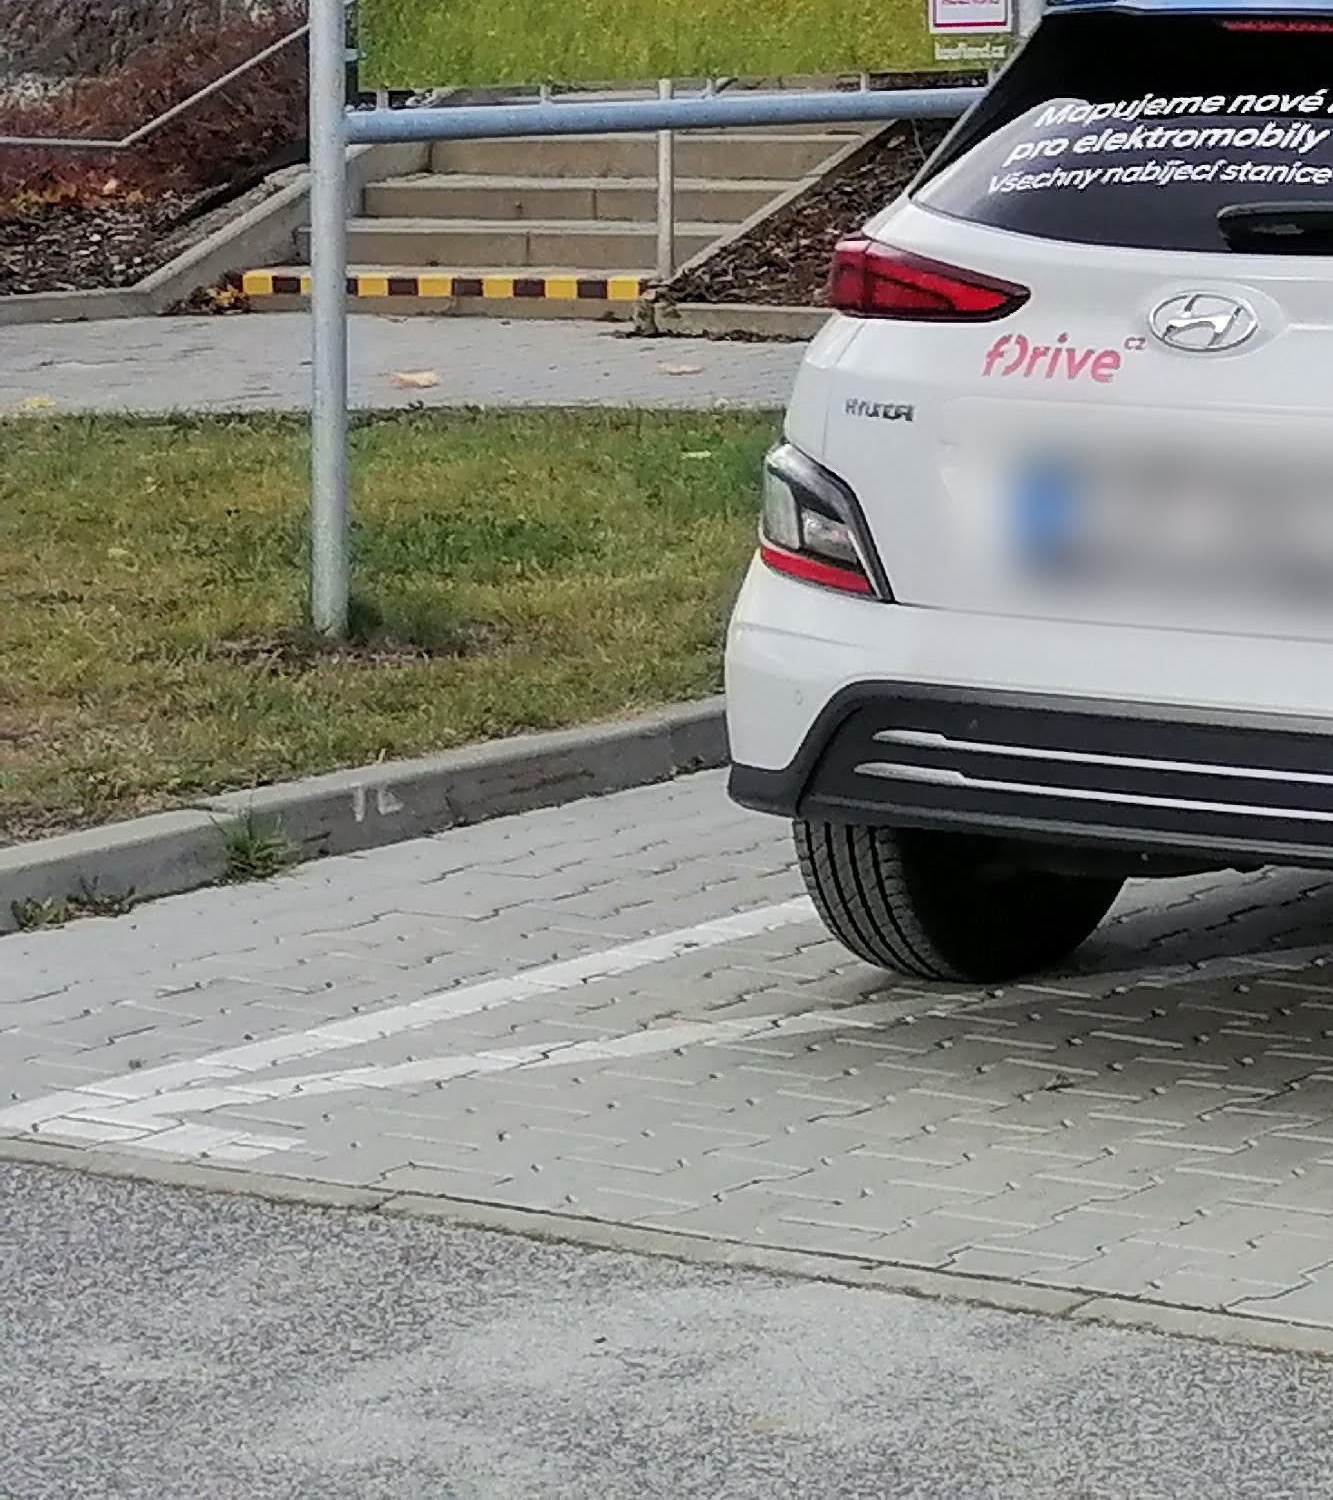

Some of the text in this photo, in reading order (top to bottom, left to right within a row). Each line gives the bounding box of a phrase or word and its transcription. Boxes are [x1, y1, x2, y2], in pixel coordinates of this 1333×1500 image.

[1035, 94, 1228, 127] Mapujeme
[1227, 88, 1329, 114] nové
[1002, 120, 1333, 167] pro elektromobily
[1101, 159, 1228, 186] nabíjecí
[1220, 161, 1333, 185] stanice
